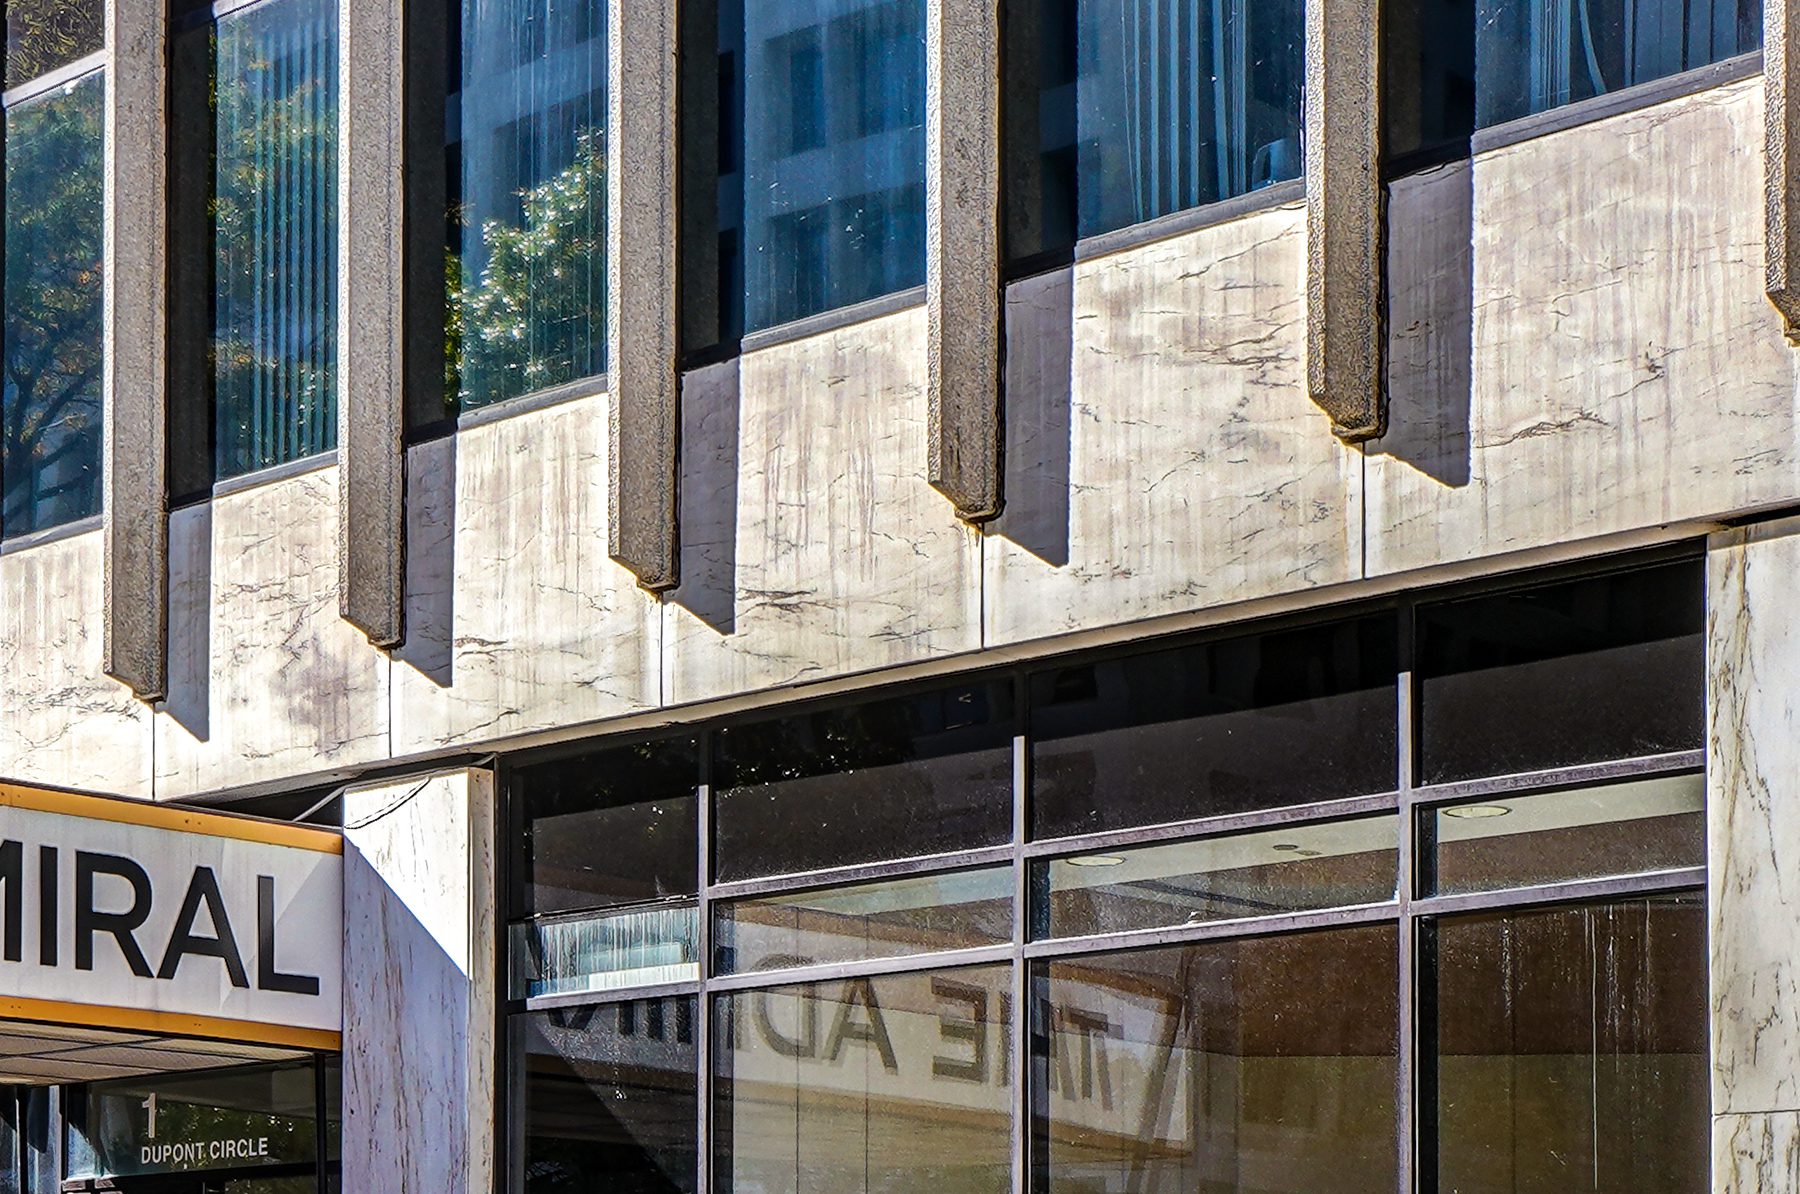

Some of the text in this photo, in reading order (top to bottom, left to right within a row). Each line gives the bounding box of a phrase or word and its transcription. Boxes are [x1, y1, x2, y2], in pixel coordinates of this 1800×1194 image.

[141, 1092, 157, 1139] 1
[141, 1137, 269, 1165] DUPONT CIRCLE
